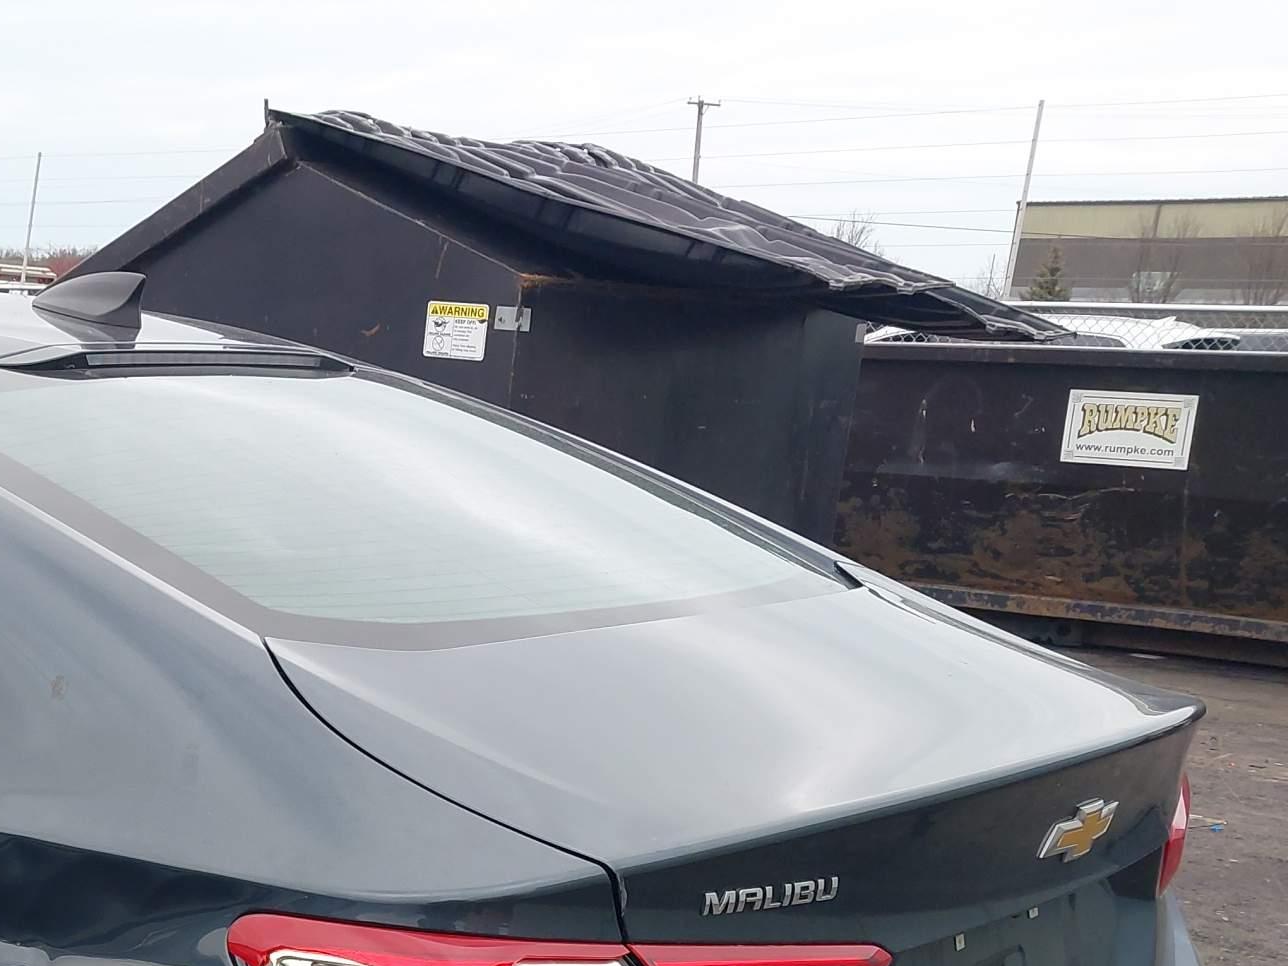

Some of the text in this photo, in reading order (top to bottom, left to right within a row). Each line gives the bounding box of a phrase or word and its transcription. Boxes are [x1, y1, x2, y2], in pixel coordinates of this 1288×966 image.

[438, 305, 485, 318] WARNING
[1078, 402, 1183, 444] RUMPKE
[1075, 443, 1175, 457] www.rumpke.com
[702, 876, 840, 916] MALIBU
